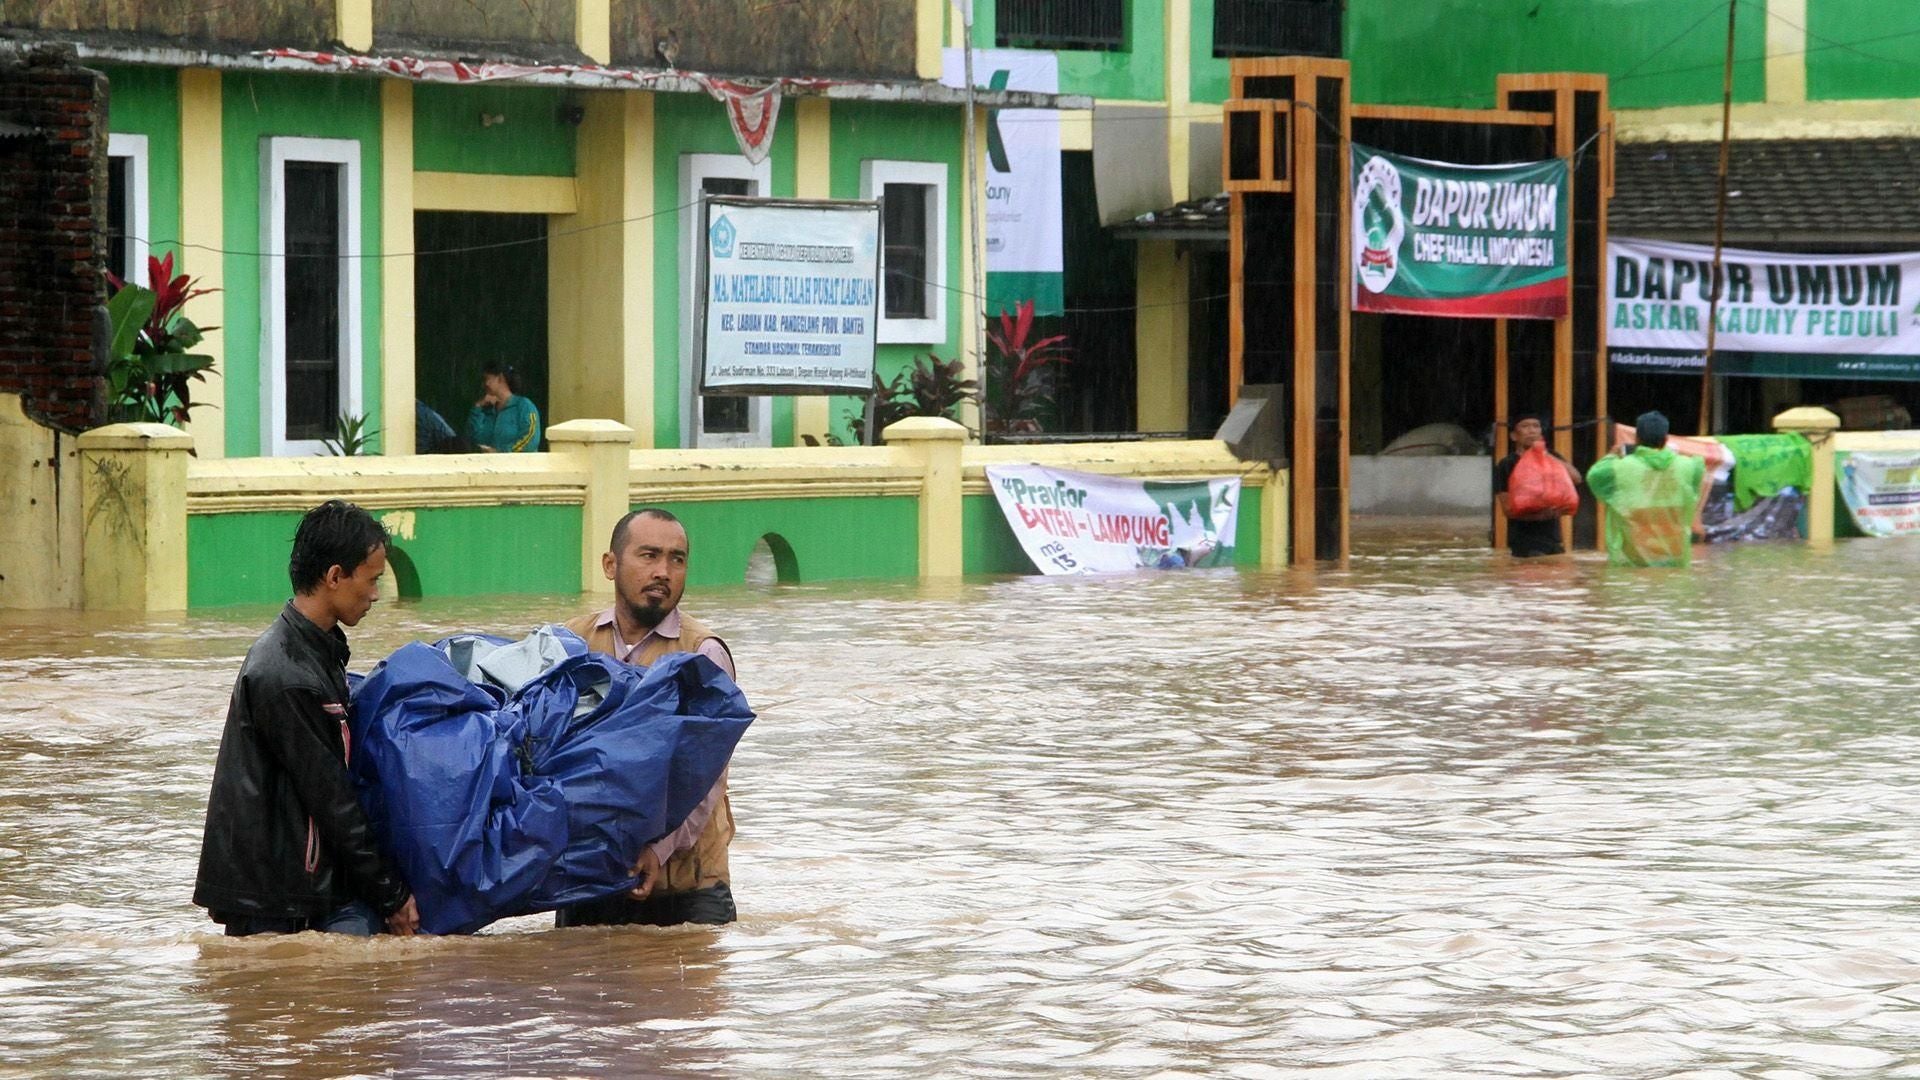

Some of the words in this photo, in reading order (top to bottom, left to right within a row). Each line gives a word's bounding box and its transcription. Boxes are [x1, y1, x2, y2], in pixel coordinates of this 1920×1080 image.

[1413, 177, 1490, 229] DAPUR
[1492, 182, 1557, 231] UMUM
[1413, 232, 1445, 262] CHEF
[1446, 235, 1488, 265] HALAL
[1488, 237, 1554, 266] INDONESIA
[784, 276, 811, 304] FALAH
[813, 277, 839, 305] PUSAT
[840, 278, 873, 305] LABUAN
[1615, 256, 1753, 304] DAPUR
[1766, 264, 1902, 306] UMUM
[738, 314, 761, 331] LABUAN
[781, 316, 820, 333] PANDEGLANG
[842, 317, 864, 334] BANTEN
[1614, 303, 1699, 331] ASKAR
[1713, 307, 1798, 335] KAUNY
[1806, 309, 1898, 336] PEDULI
[744, 342, 771, 354] STANDAR
[772, 343, 801, 355] NASIONAL
[1087, 512, 1169, 546] LAMPUNG
